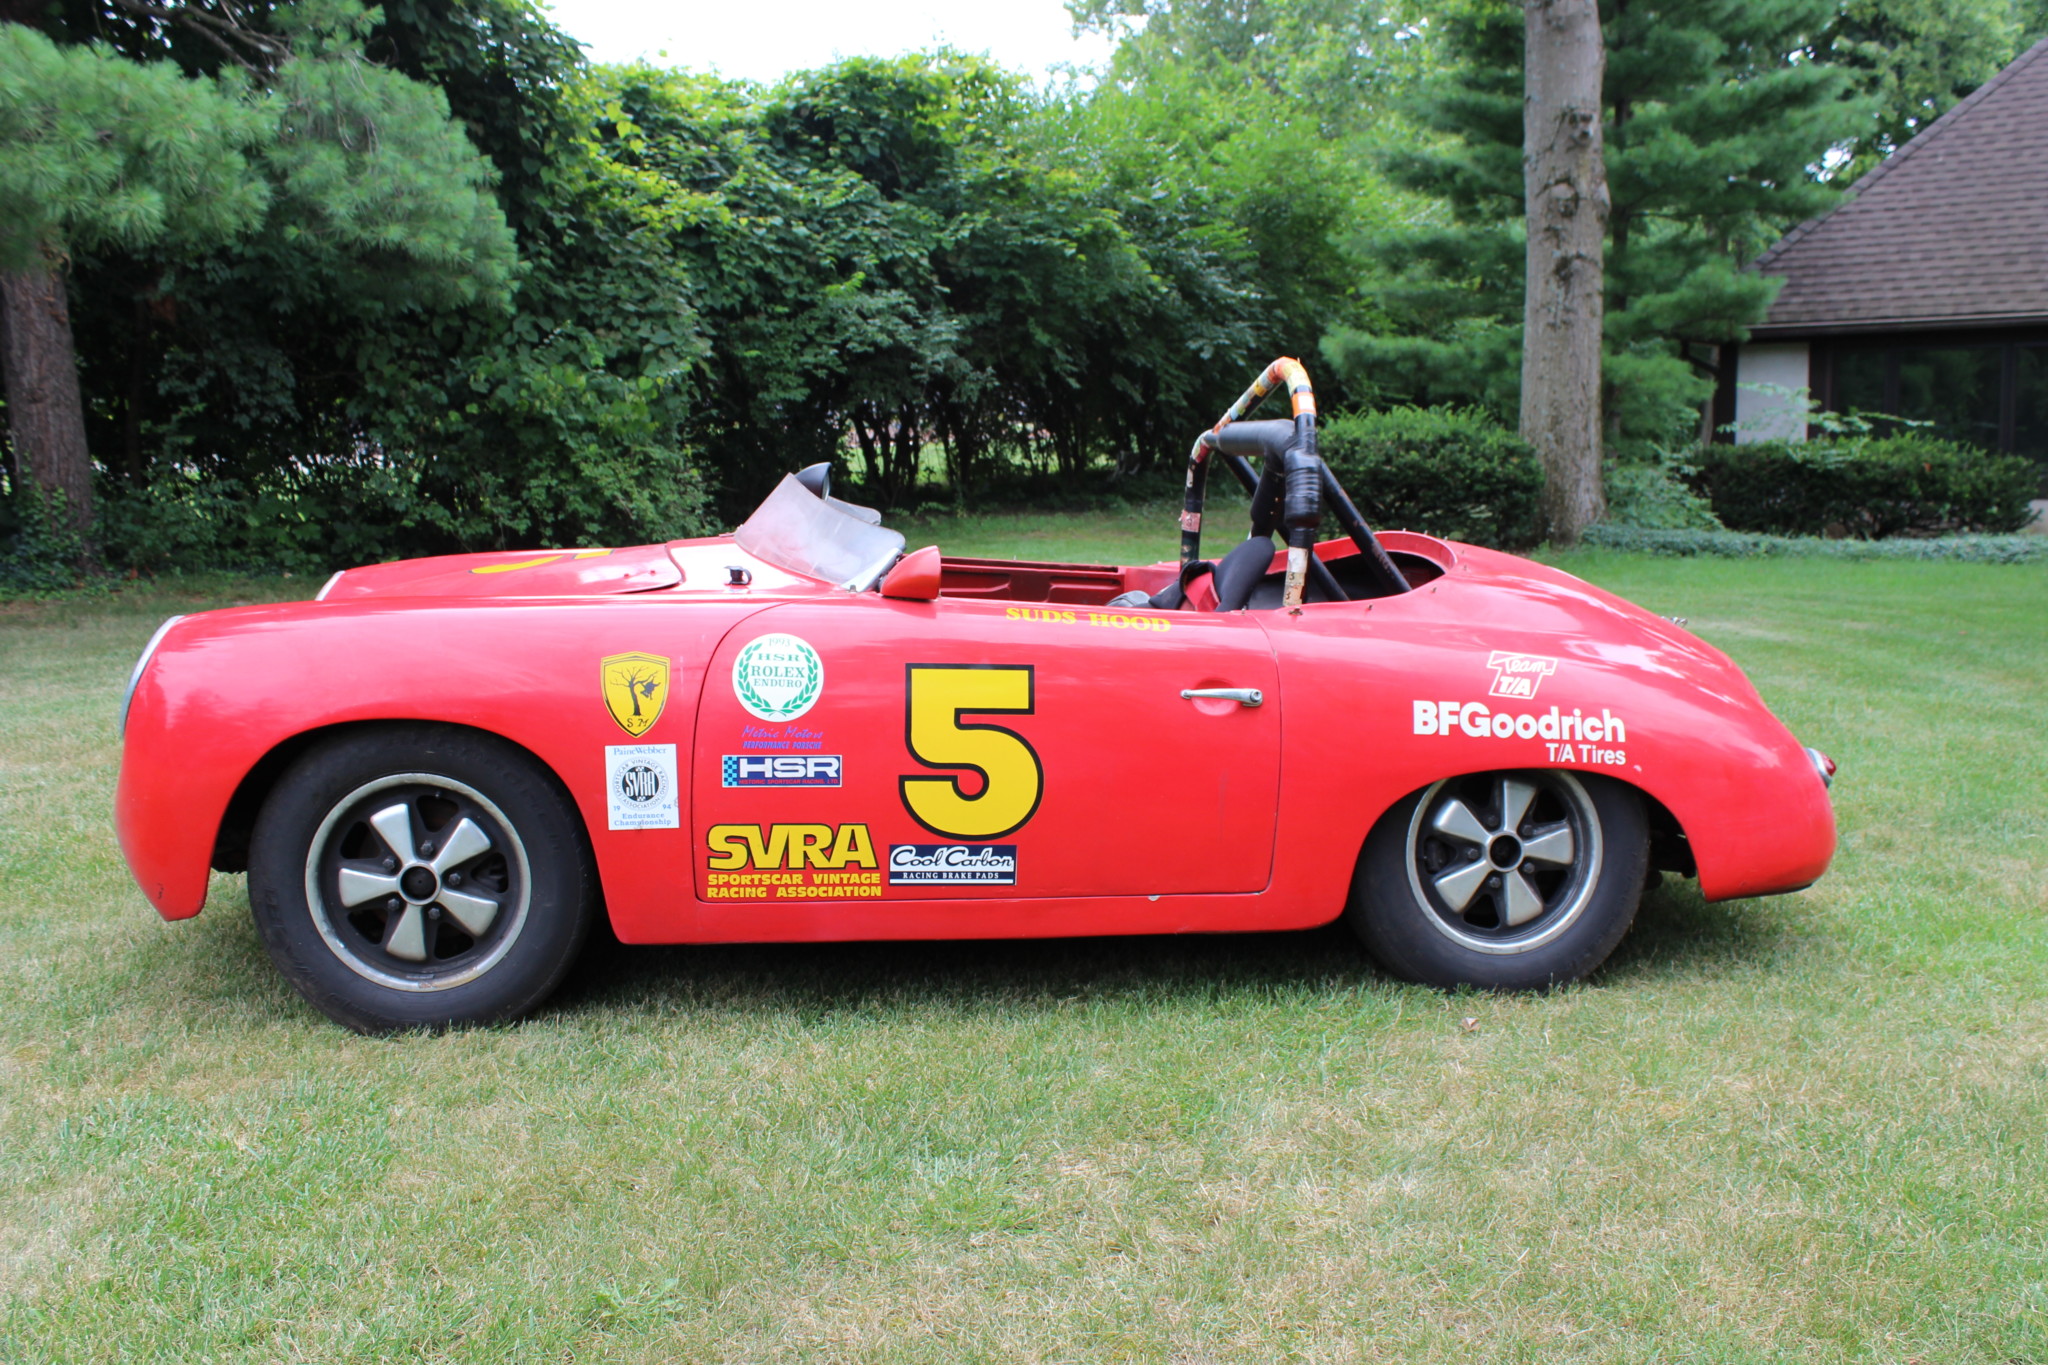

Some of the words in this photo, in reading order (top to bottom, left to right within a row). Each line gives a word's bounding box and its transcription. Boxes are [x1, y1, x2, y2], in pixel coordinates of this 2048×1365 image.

[1006, 607, 1078, 625] SUDS
[1088, 612, 1172, 632] HOOD
[768, 637, 791, 647] 1993
[758, 653, 800, 662] HSR
[1492, 656, 1553, 674] Team
[750, 665, 806, 679] ROLEX
[753, 678, 803, 688] ENDURO
[1499, 676, 1531, 696] T/A
[1413, 699, 1626, 743] BFGoodrich
[613, 746, 667, 756] PaineWebber
[742, 741, 789, 749] PERFORMANCE
[898, 663, 1045, 842] 5
[1545, 743, 1576, 763] T/A
[1578, 745, 1626, 765] Tires
[739, 757, 840, 778] HSR
[625, 771, 656, 797] SVRA
[622, 812, 665, 820] Endurance
[706, 823, 879, 871] SVRA
[892, 848, 944, 867] Cool
[945, 849, 1013, 867] Carbon
[707, 874, 803, 886] SPORTSCAR
[813, 873, 880, 885] VINTAGE
[706, 886, 767, 898] RACING
[776, 886, 882, 898] ASSOCIATION
